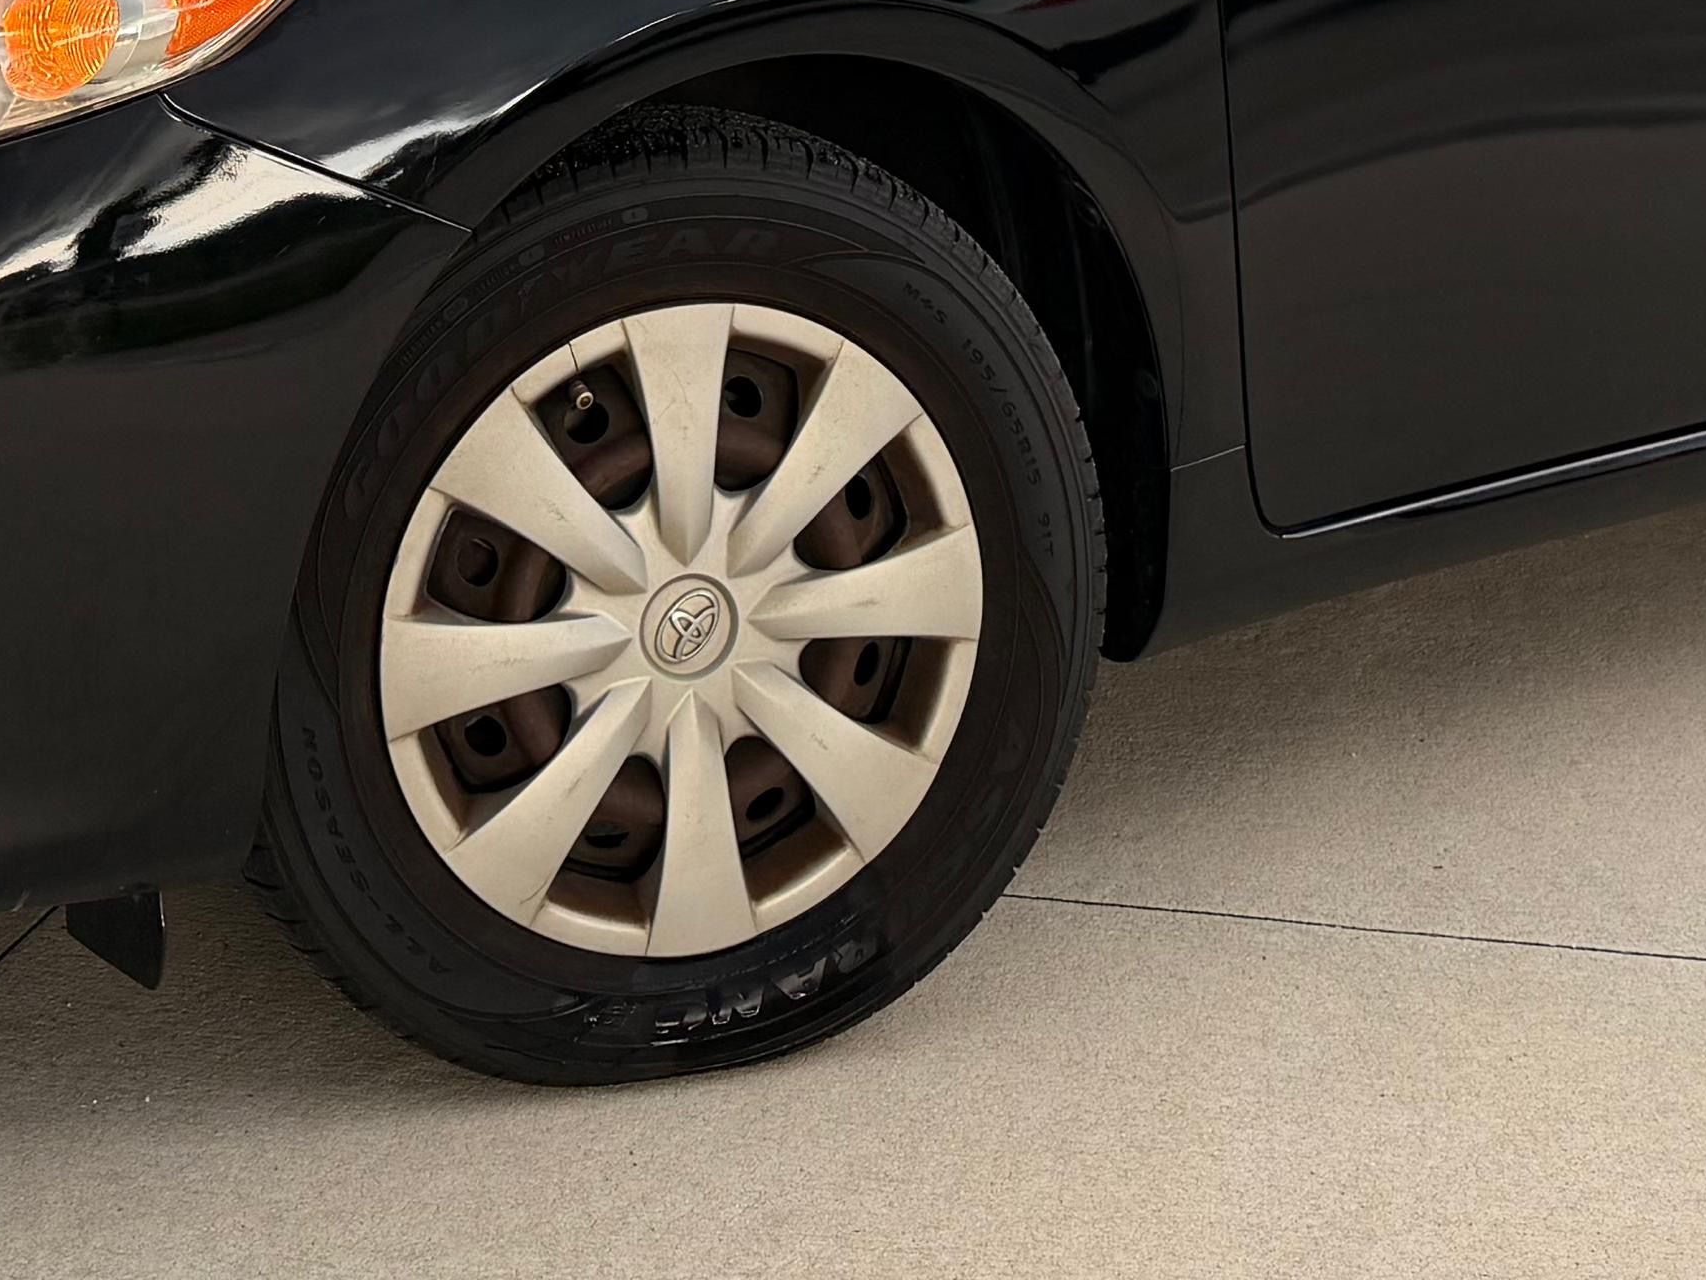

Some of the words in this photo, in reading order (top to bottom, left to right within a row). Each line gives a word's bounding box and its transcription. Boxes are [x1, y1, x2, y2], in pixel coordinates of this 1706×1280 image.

[961, 339, 1042, 486] 195/65R15
[1037, 513, 1054, 558] 91T
[301, 727, 454, 974] ALL-SEASON
